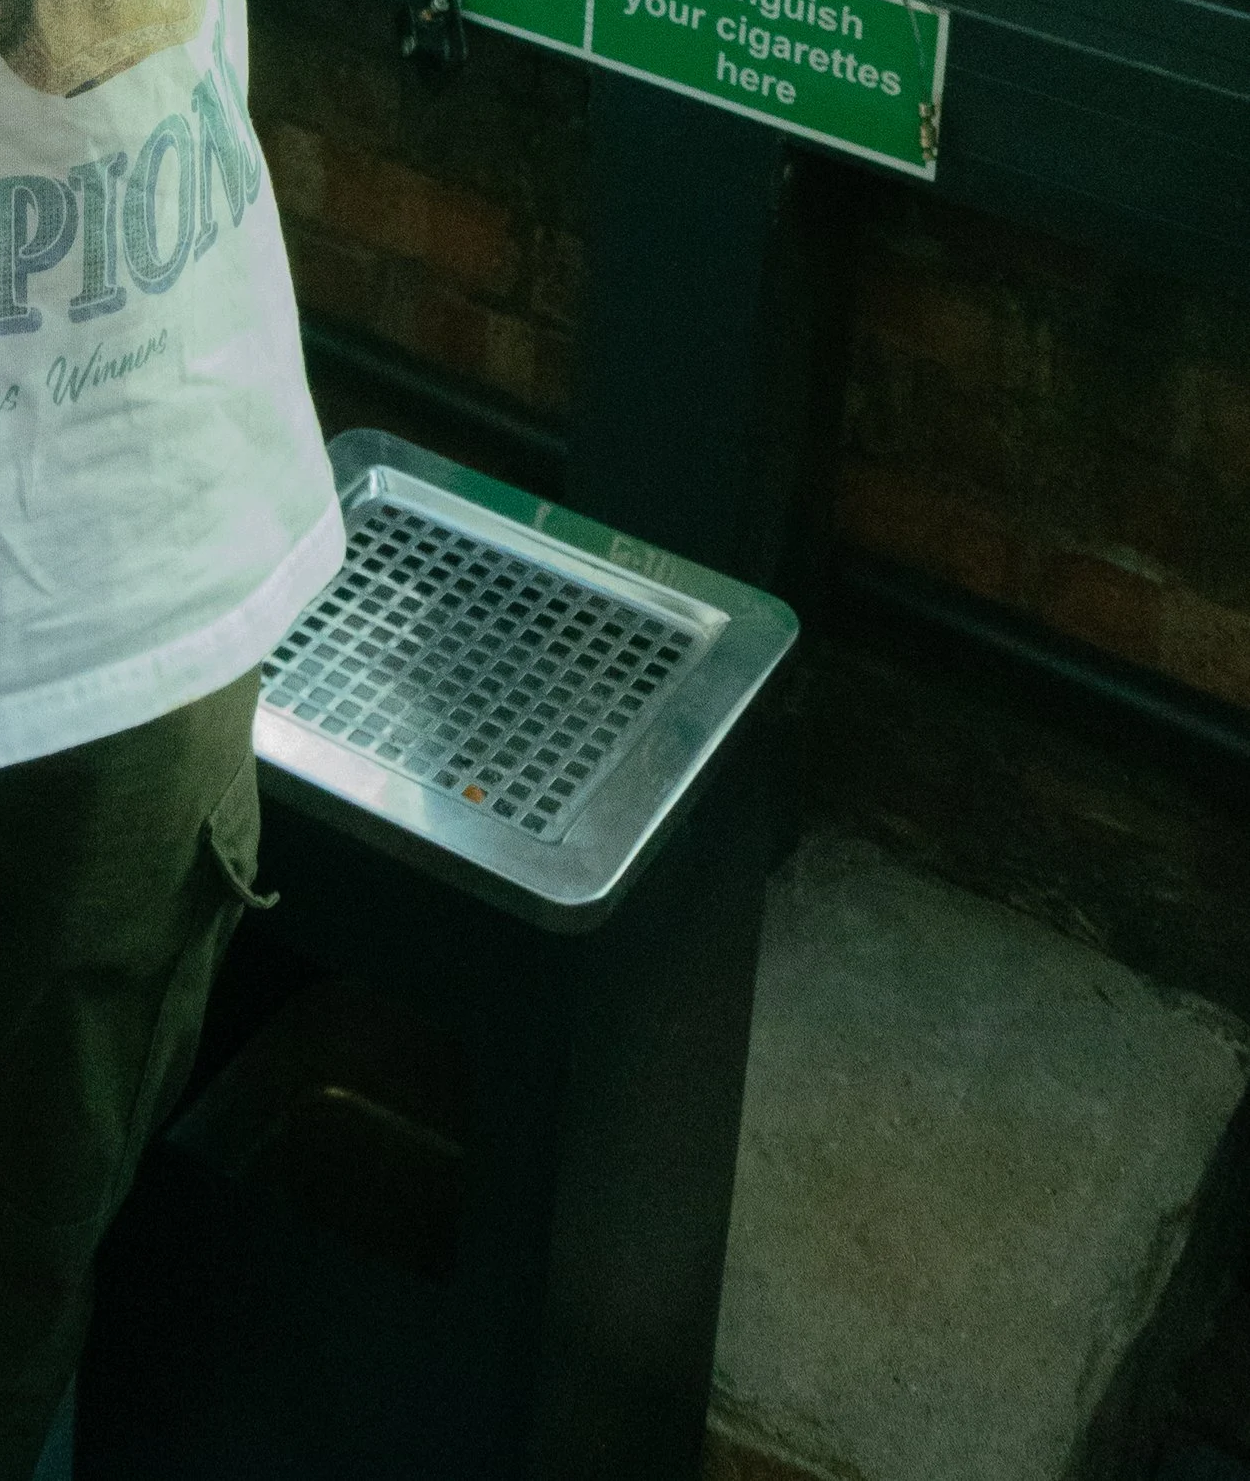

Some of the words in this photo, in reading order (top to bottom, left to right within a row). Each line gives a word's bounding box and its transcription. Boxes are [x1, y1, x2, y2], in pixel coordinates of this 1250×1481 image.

[716, 10, 902, 98] cigarettes
[716, 52, 797, 106] here
[47, 327, 169, 407] Winners
